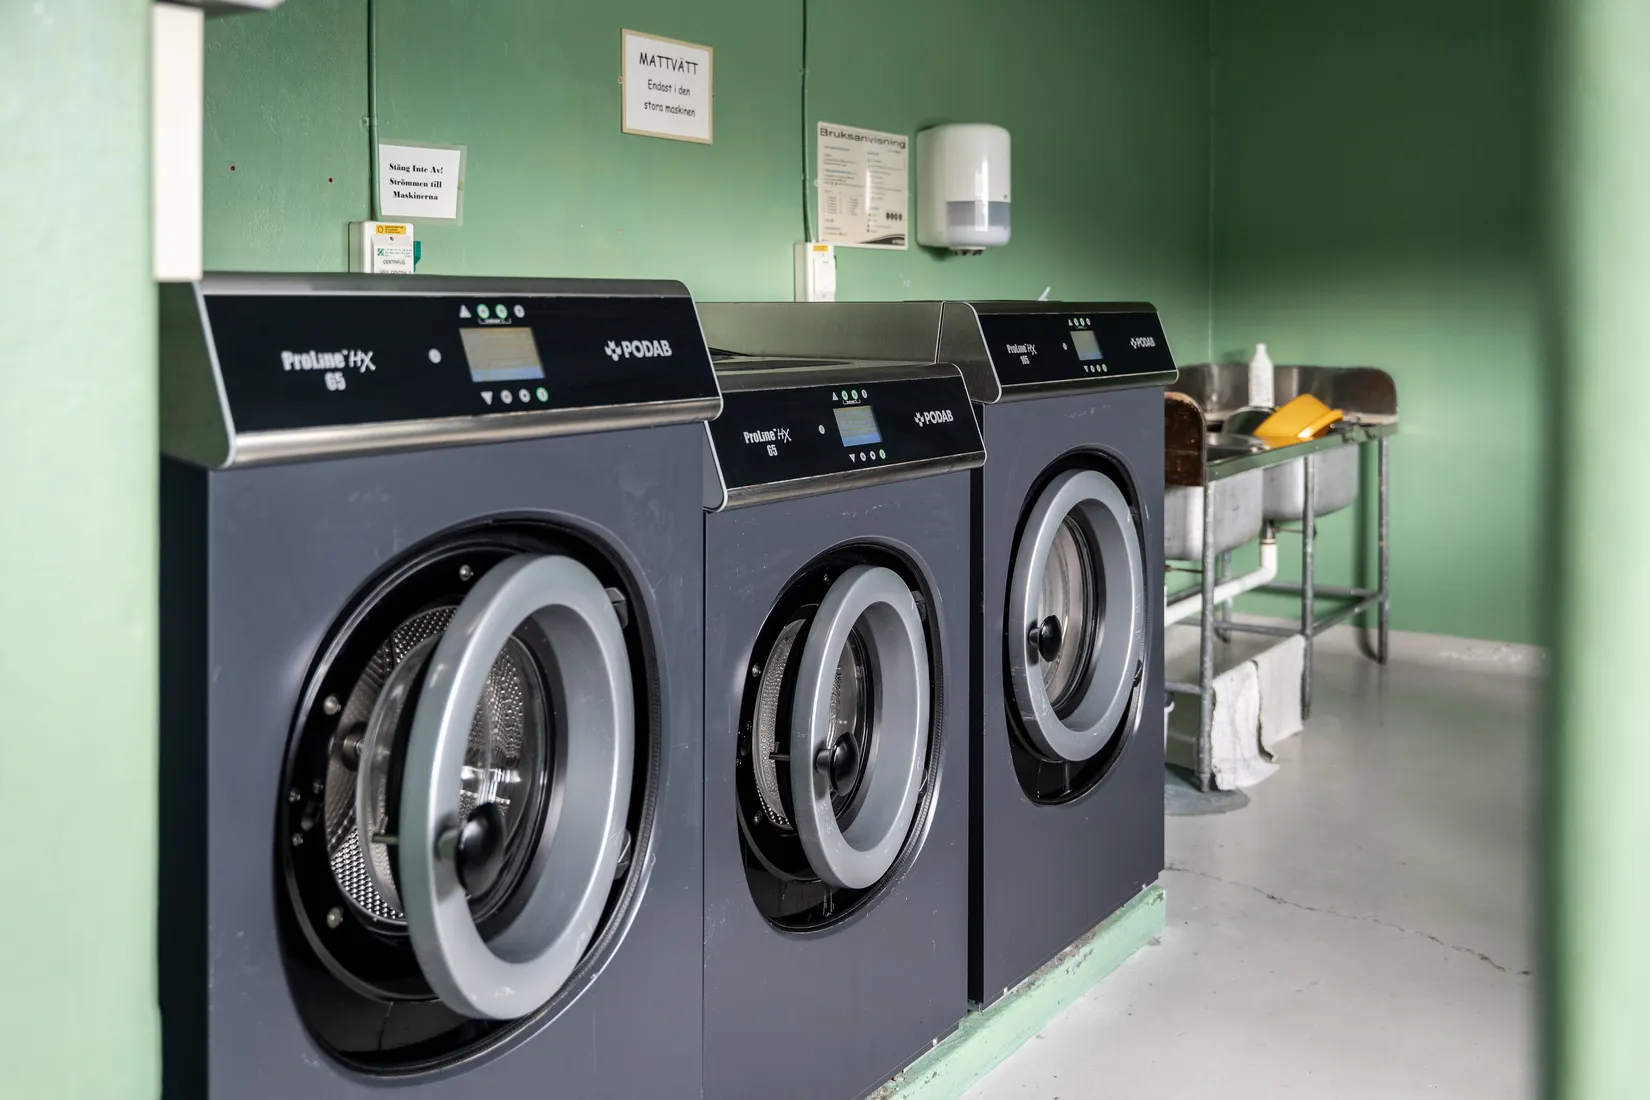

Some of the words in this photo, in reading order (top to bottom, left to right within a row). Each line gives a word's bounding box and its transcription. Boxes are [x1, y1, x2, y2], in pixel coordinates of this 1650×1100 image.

[639, 52, 698, 74] MATTVÄTT
[647, 79, 672, 92] Endast
[678, 84, 691, 97] den
[644, 100, 664, 112] stora
[665, 104, 696, 118] maskinen
[820, 127, 906, 149] Bruksanvisning
[389, 163, 411, 173] Stäng
[412, 164, 429, 173] Inte
[430, 166, 444, 174] Av!
[389, 177, 429, 188] Strömmen
[430, 180, 442, 188] till
[392, 190, 439, 201] Maskinerna
[621, 339, 672, 359] PODAB
[348, 349, 377, 373] HX
[324, 371, 347, 391] 65
[923, 409, 954, 425] PODAB
[777, 428, 792, 444] HX
[766, 444, 779, 457] 65
